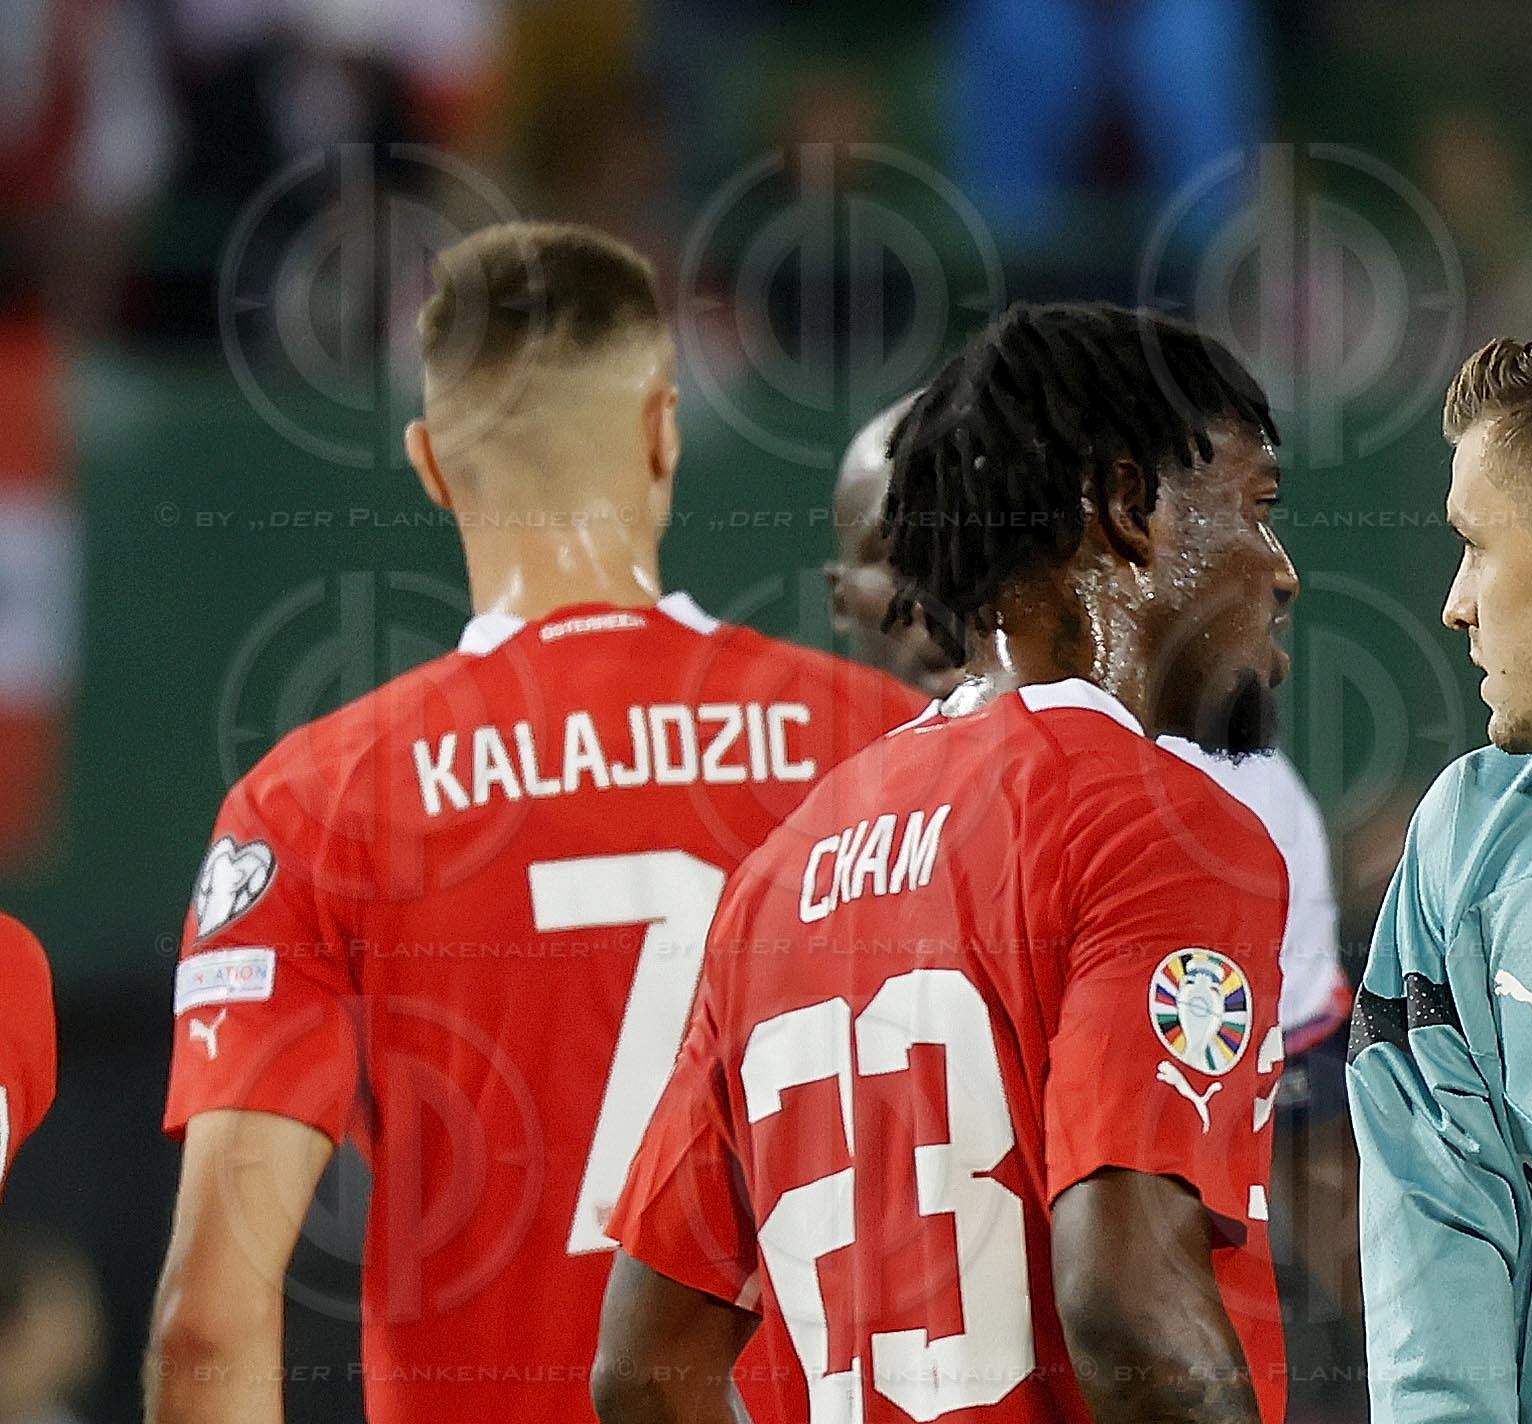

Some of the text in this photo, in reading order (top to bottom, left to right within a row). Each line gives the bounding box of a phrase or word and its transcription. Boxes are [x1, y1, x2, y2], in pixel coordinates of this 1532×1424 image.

[411, 703, 817, 816] KALAJDZIC
[800, 803, 952, 924] CHAM
[527, 849, 727, 1255] 7
